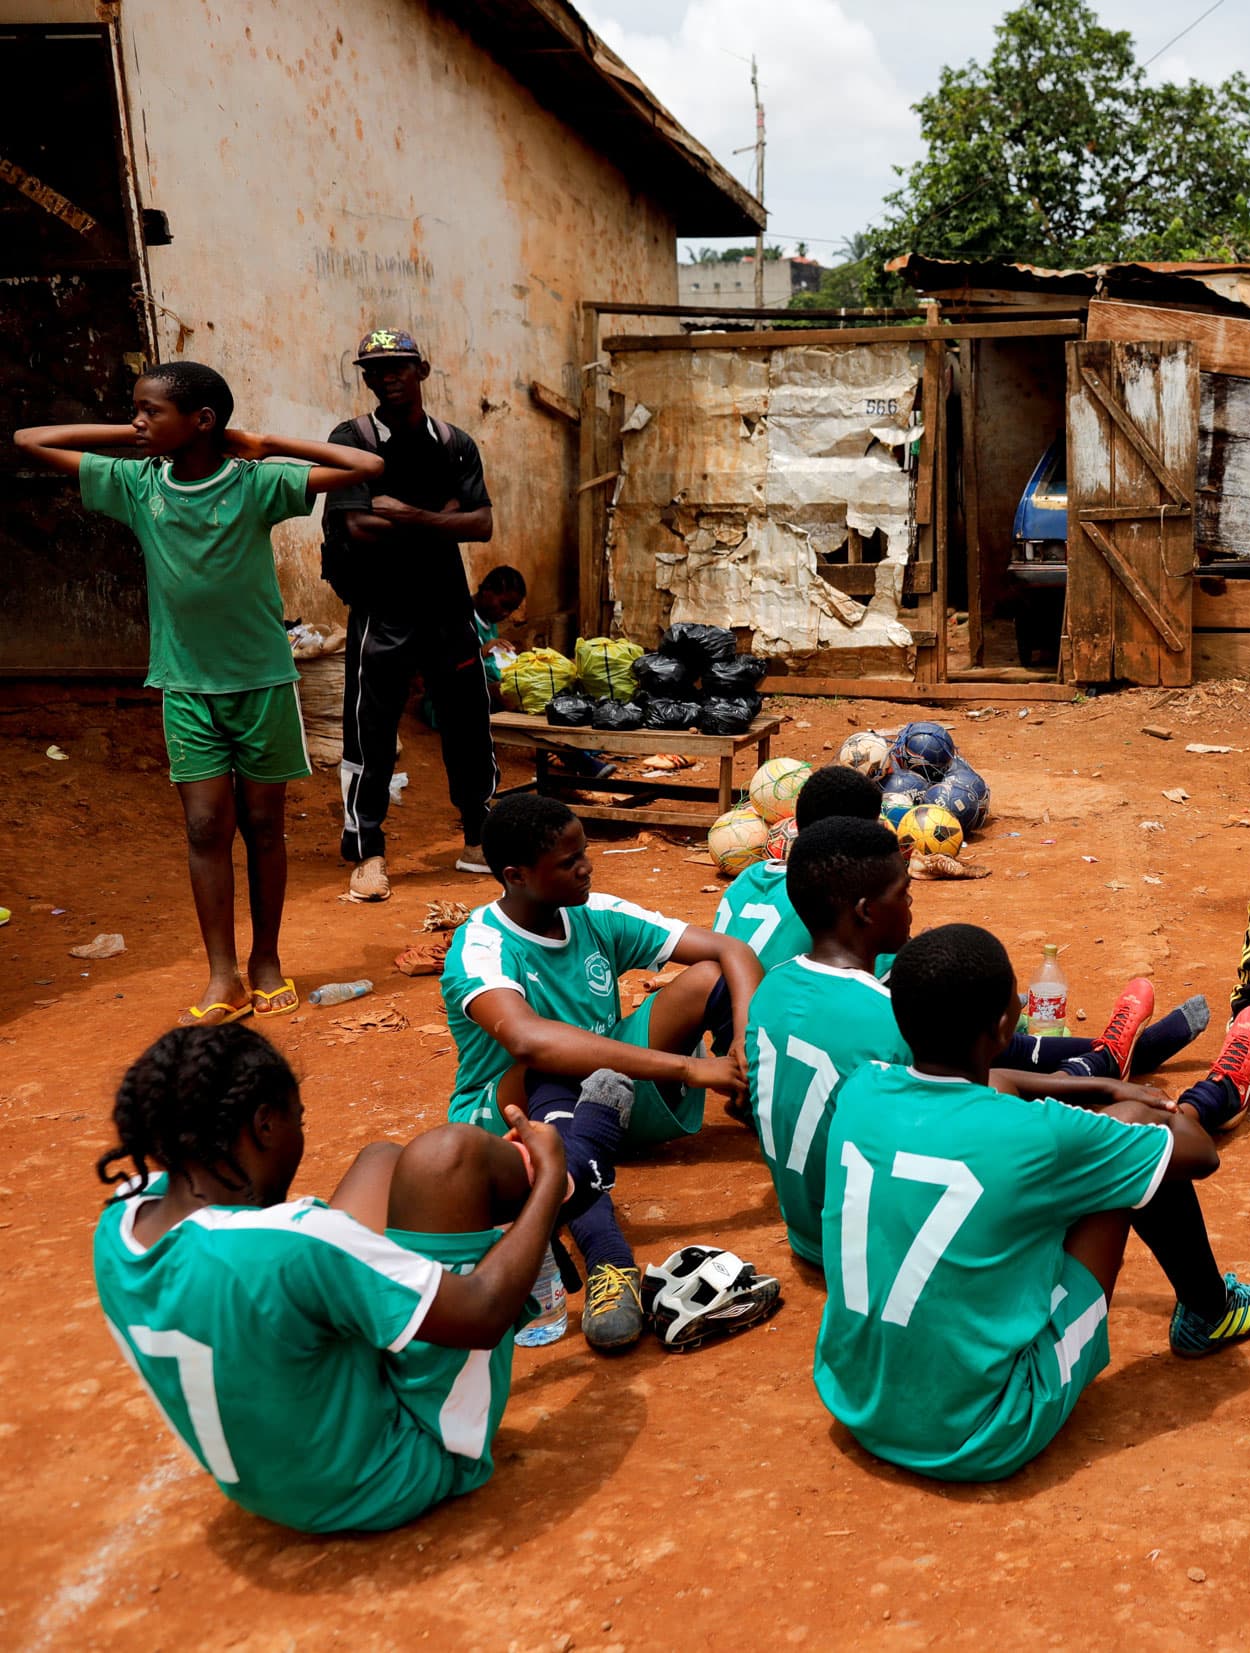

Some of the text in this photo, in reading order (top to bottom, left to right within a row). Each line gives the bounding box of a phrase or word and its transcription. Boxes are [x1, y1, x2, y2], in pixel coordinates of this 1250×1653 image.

[371, 330, 396, 348] NY
[863, 399, 897, 415] 566
[757, 1026, 840, 1176] 17
[841, 1141, 984, 1327] 17
